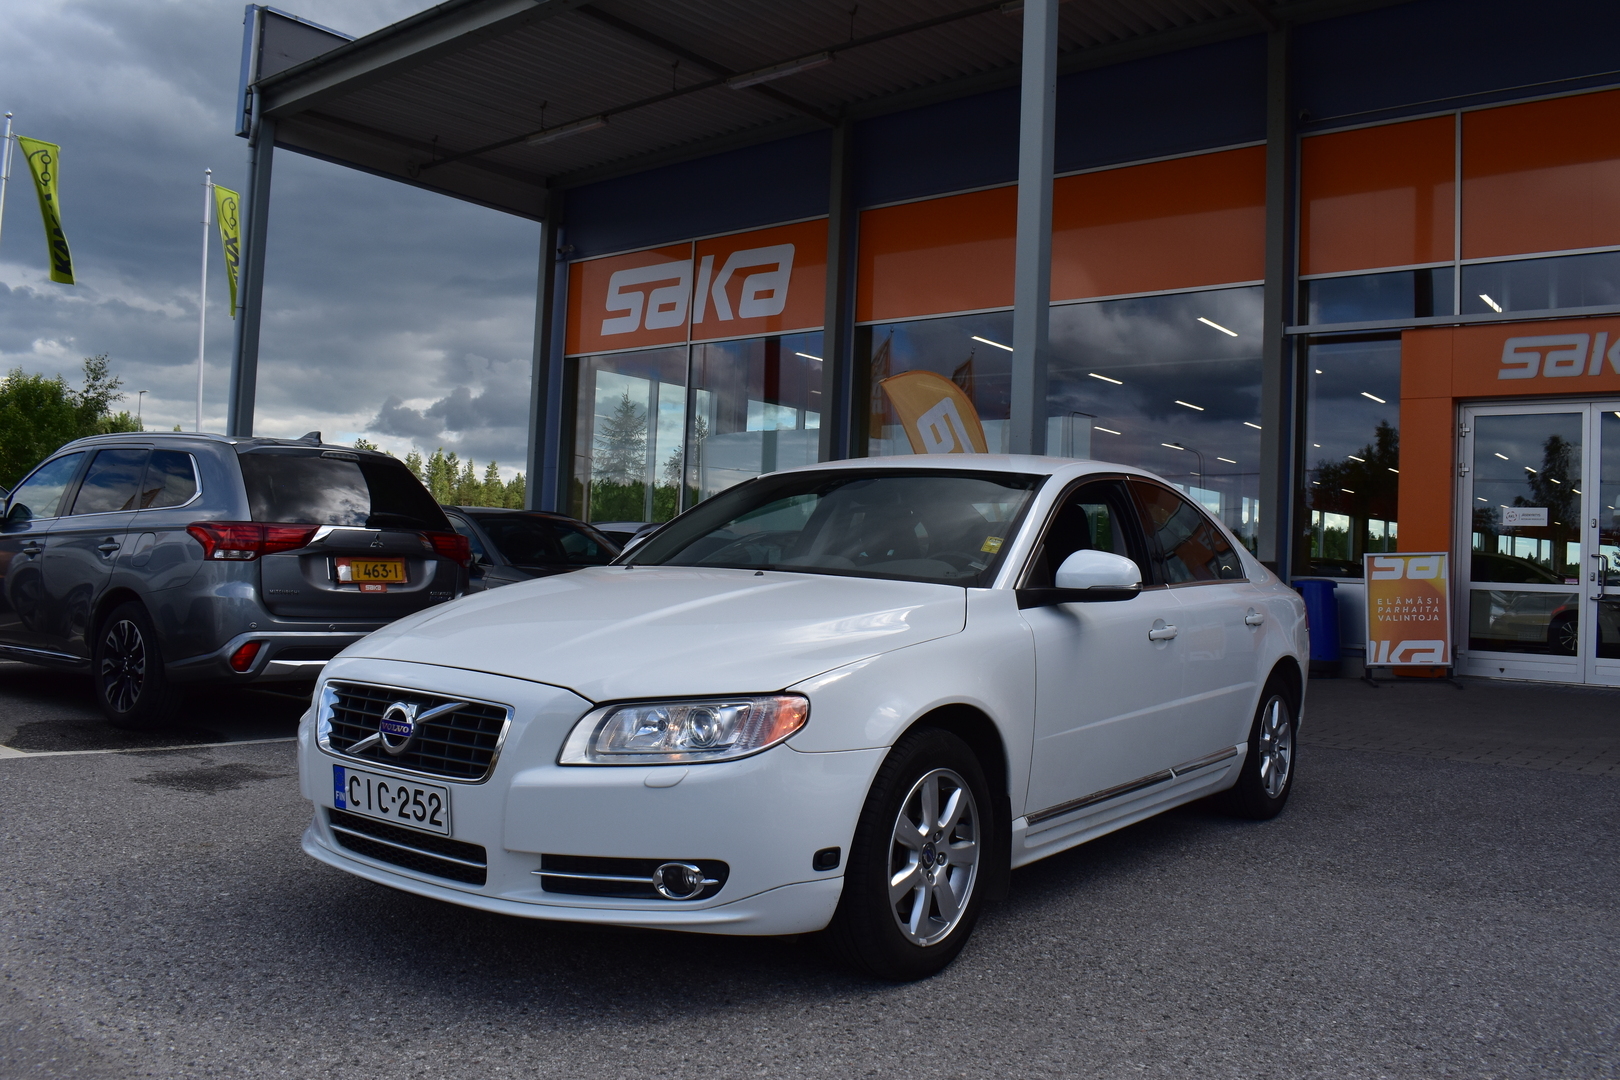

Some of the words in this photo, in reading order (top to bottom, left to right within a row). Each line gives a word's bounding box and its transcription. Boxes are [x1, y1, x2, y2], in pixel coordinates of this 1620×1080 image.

[1377, 596, 1439, 605] ELÄMÄSI
[1377, 606, 1439, 614] PARHAITA
[381, 722, 410, 734] VOLVO
[349, 775, 443, 827] CIC-252
